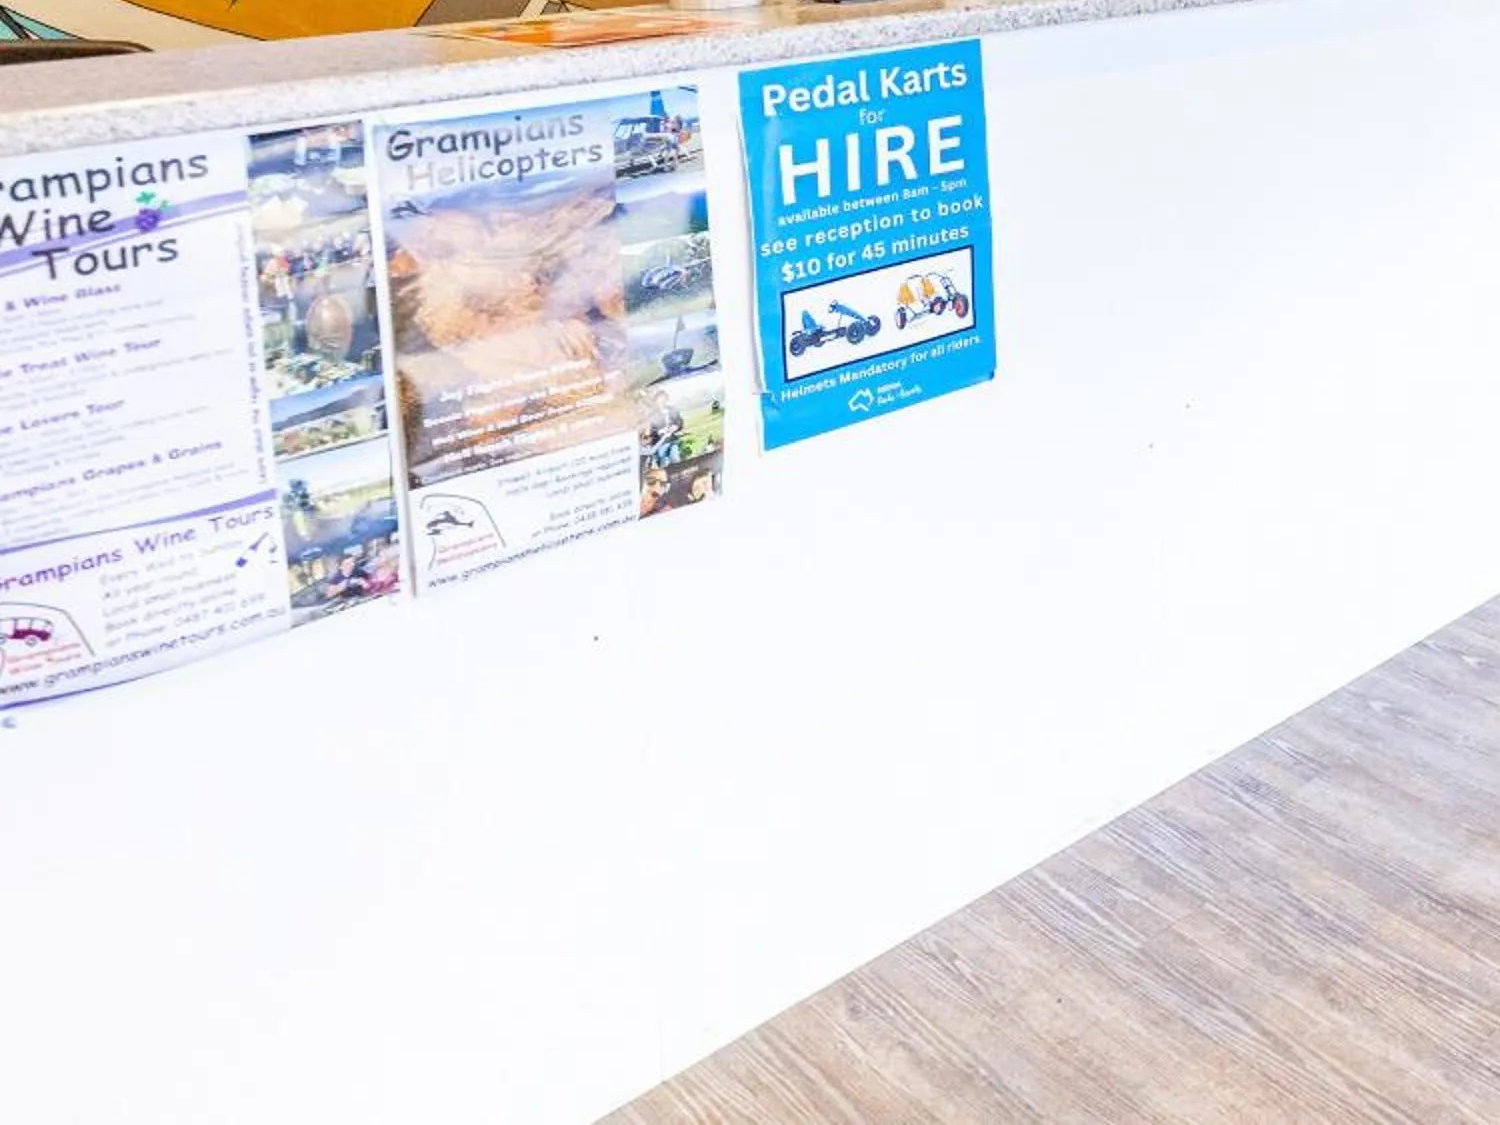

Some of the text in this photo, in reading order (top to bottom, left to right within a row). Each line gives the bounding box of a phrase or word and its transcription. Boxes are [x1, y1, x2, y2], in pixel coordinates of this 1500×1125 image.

[762, 61, 967, 117] Pedal Karts
[387, 115, 584, 162] Grampians
[859, 108, 886, 125] for
[406, 143, 603, 191] Helicopters
[778, 114, 965, 206] HIRE
[761, 194, 984, 257] see reception to book
[778, 205, 840, 227] available
[843, 191, 899, 212] between
[903, 186, 929, 201] 8am
[940, 178, 967, 193] 5pm
[0, 208, 116, 246] Wine
[32, 238, 179, 279] Tours
[780, 226, 970, 283] $10 for 45 minutes
[781, 334, 981, 403] Helmets Mandatory for all riders
[134, 528, 196, 554] Wine
[208, 506, 274, 533] Tours
